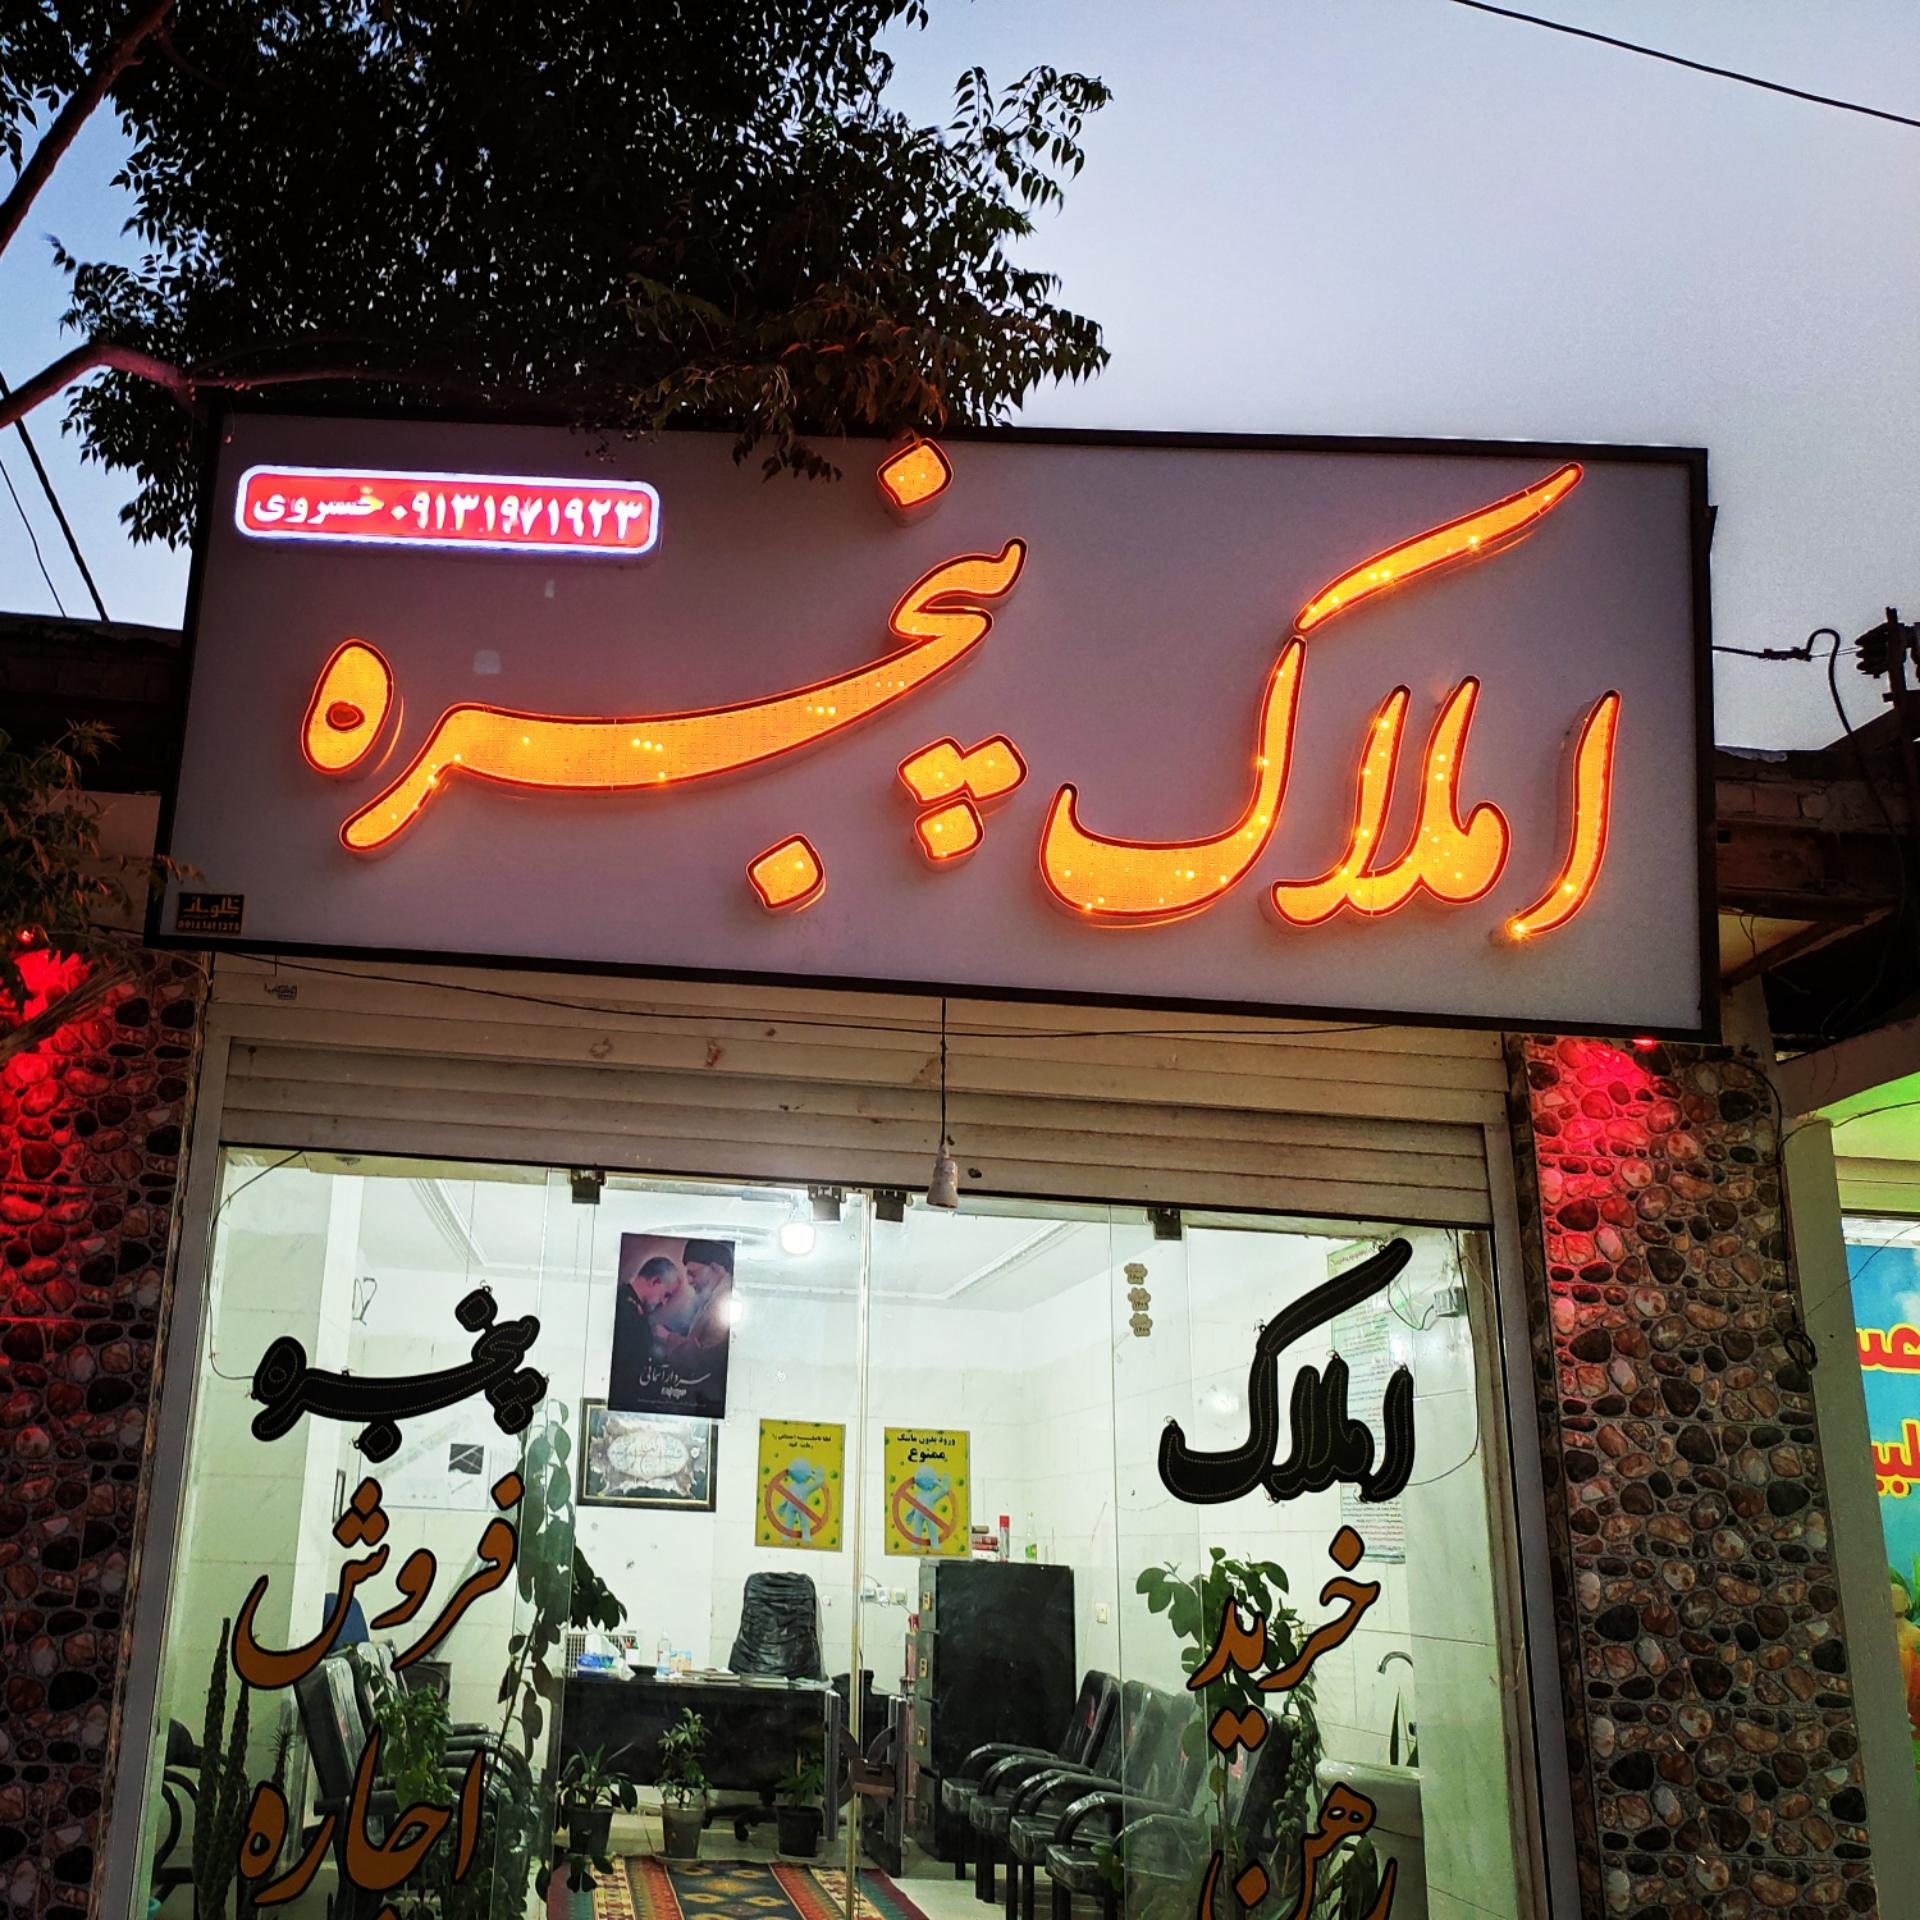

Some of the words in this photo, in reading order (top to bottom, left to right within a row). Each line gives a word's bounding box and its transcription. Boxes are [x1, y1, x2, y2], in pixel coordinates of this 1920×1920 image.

[253, 486, 385, 525] خسروی
[390, 490, 644, 540] ۰۹۱۳۱۹۷۱۹۲۳
[301, 437, 1029, 910] پنجره
[1040, 462, 1622, 928] املاک
[1158, 1238, 1415, 1503] املاک
[896, 1433, 917, 1442] ماسک
[907, 1447, 946, 1463] ممنوع
[918, 1436, 937, 1445] بدون
[938, 1436, 956, 1446] ورود
[231, 1471, 525, 1690] فروش
[1187, 1525, 1381, 1752] خرید
